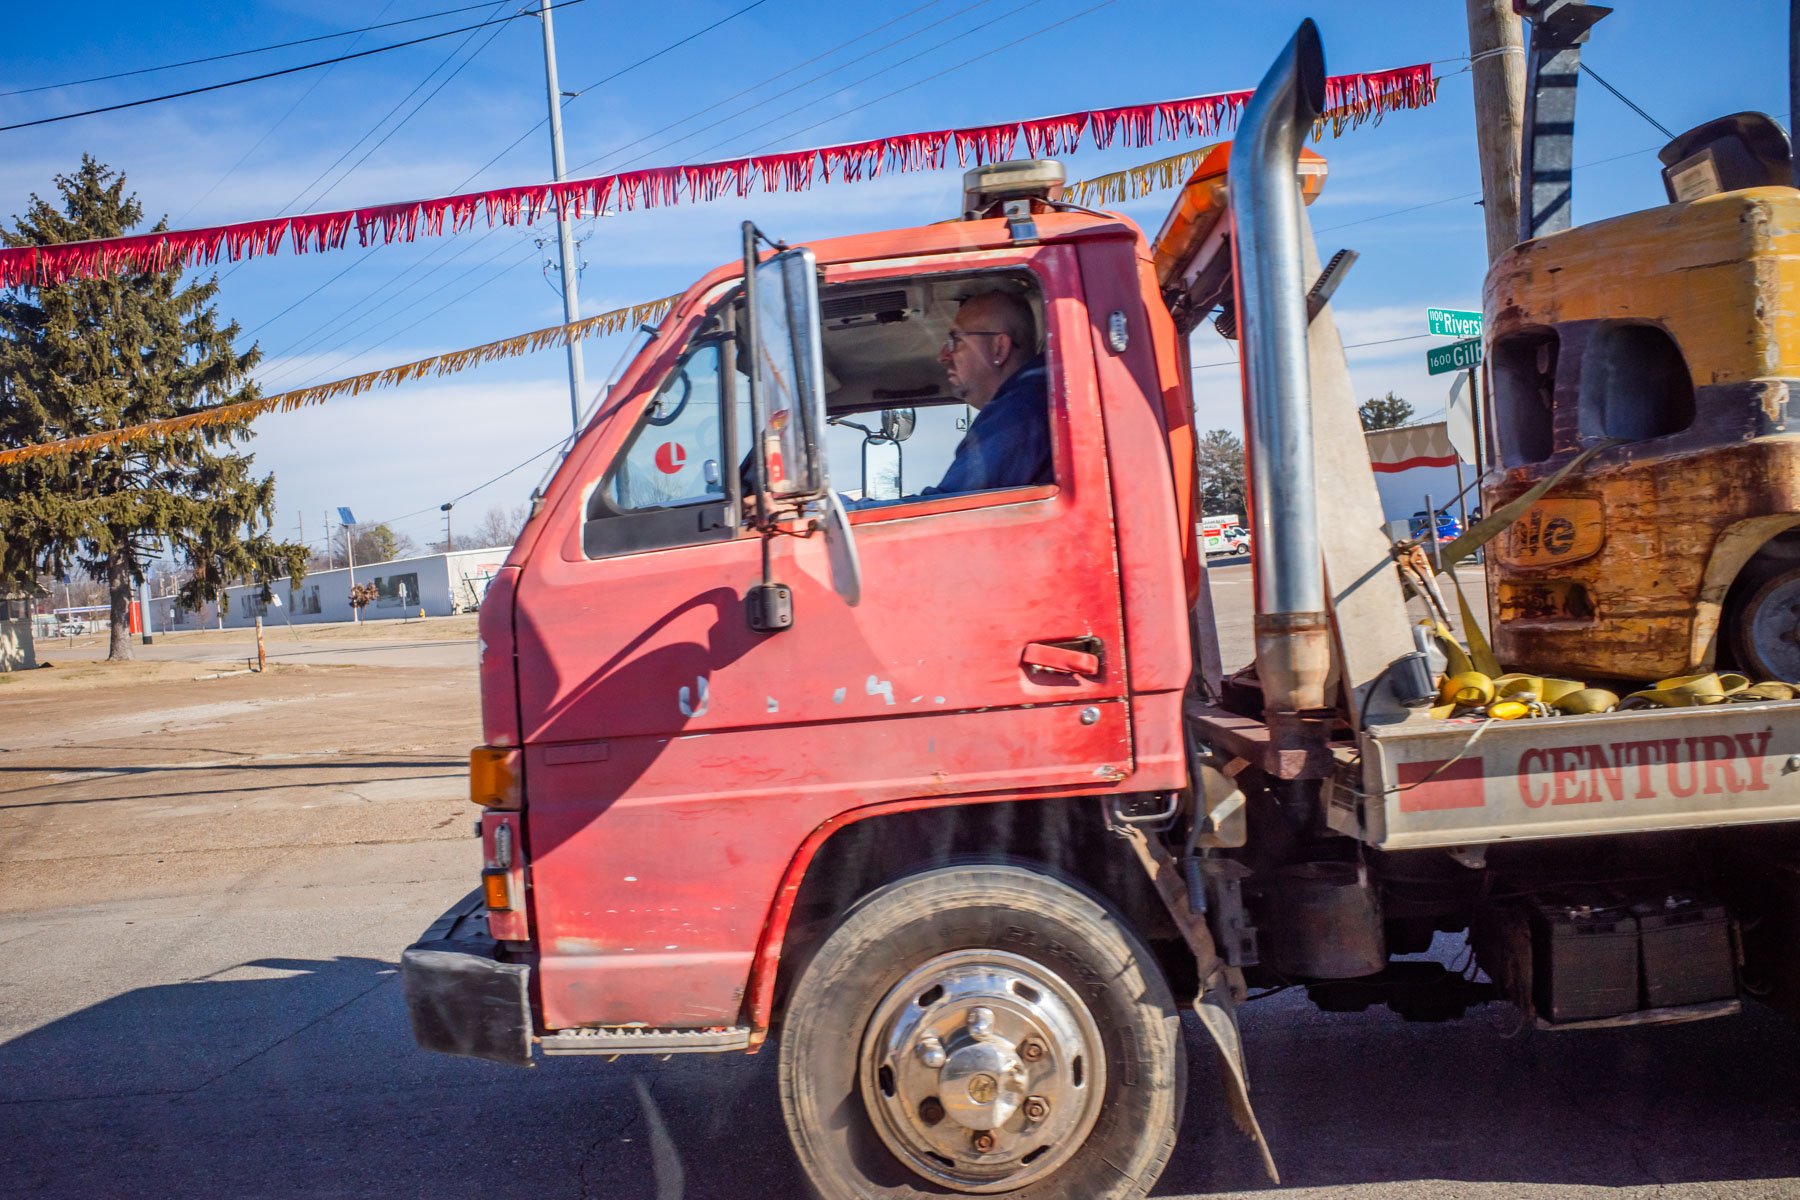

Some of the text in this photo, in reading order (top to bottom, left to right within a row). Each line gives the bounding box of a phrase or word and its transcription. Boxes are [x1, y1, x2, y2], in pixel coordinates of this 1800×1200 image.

[1429, 310, 1443, 321] 1100
[1436, 323, 1440, 333] E
[1430, 354, 1451, 367] 1600
[1517, 731, 1772, 809] CENTURY
